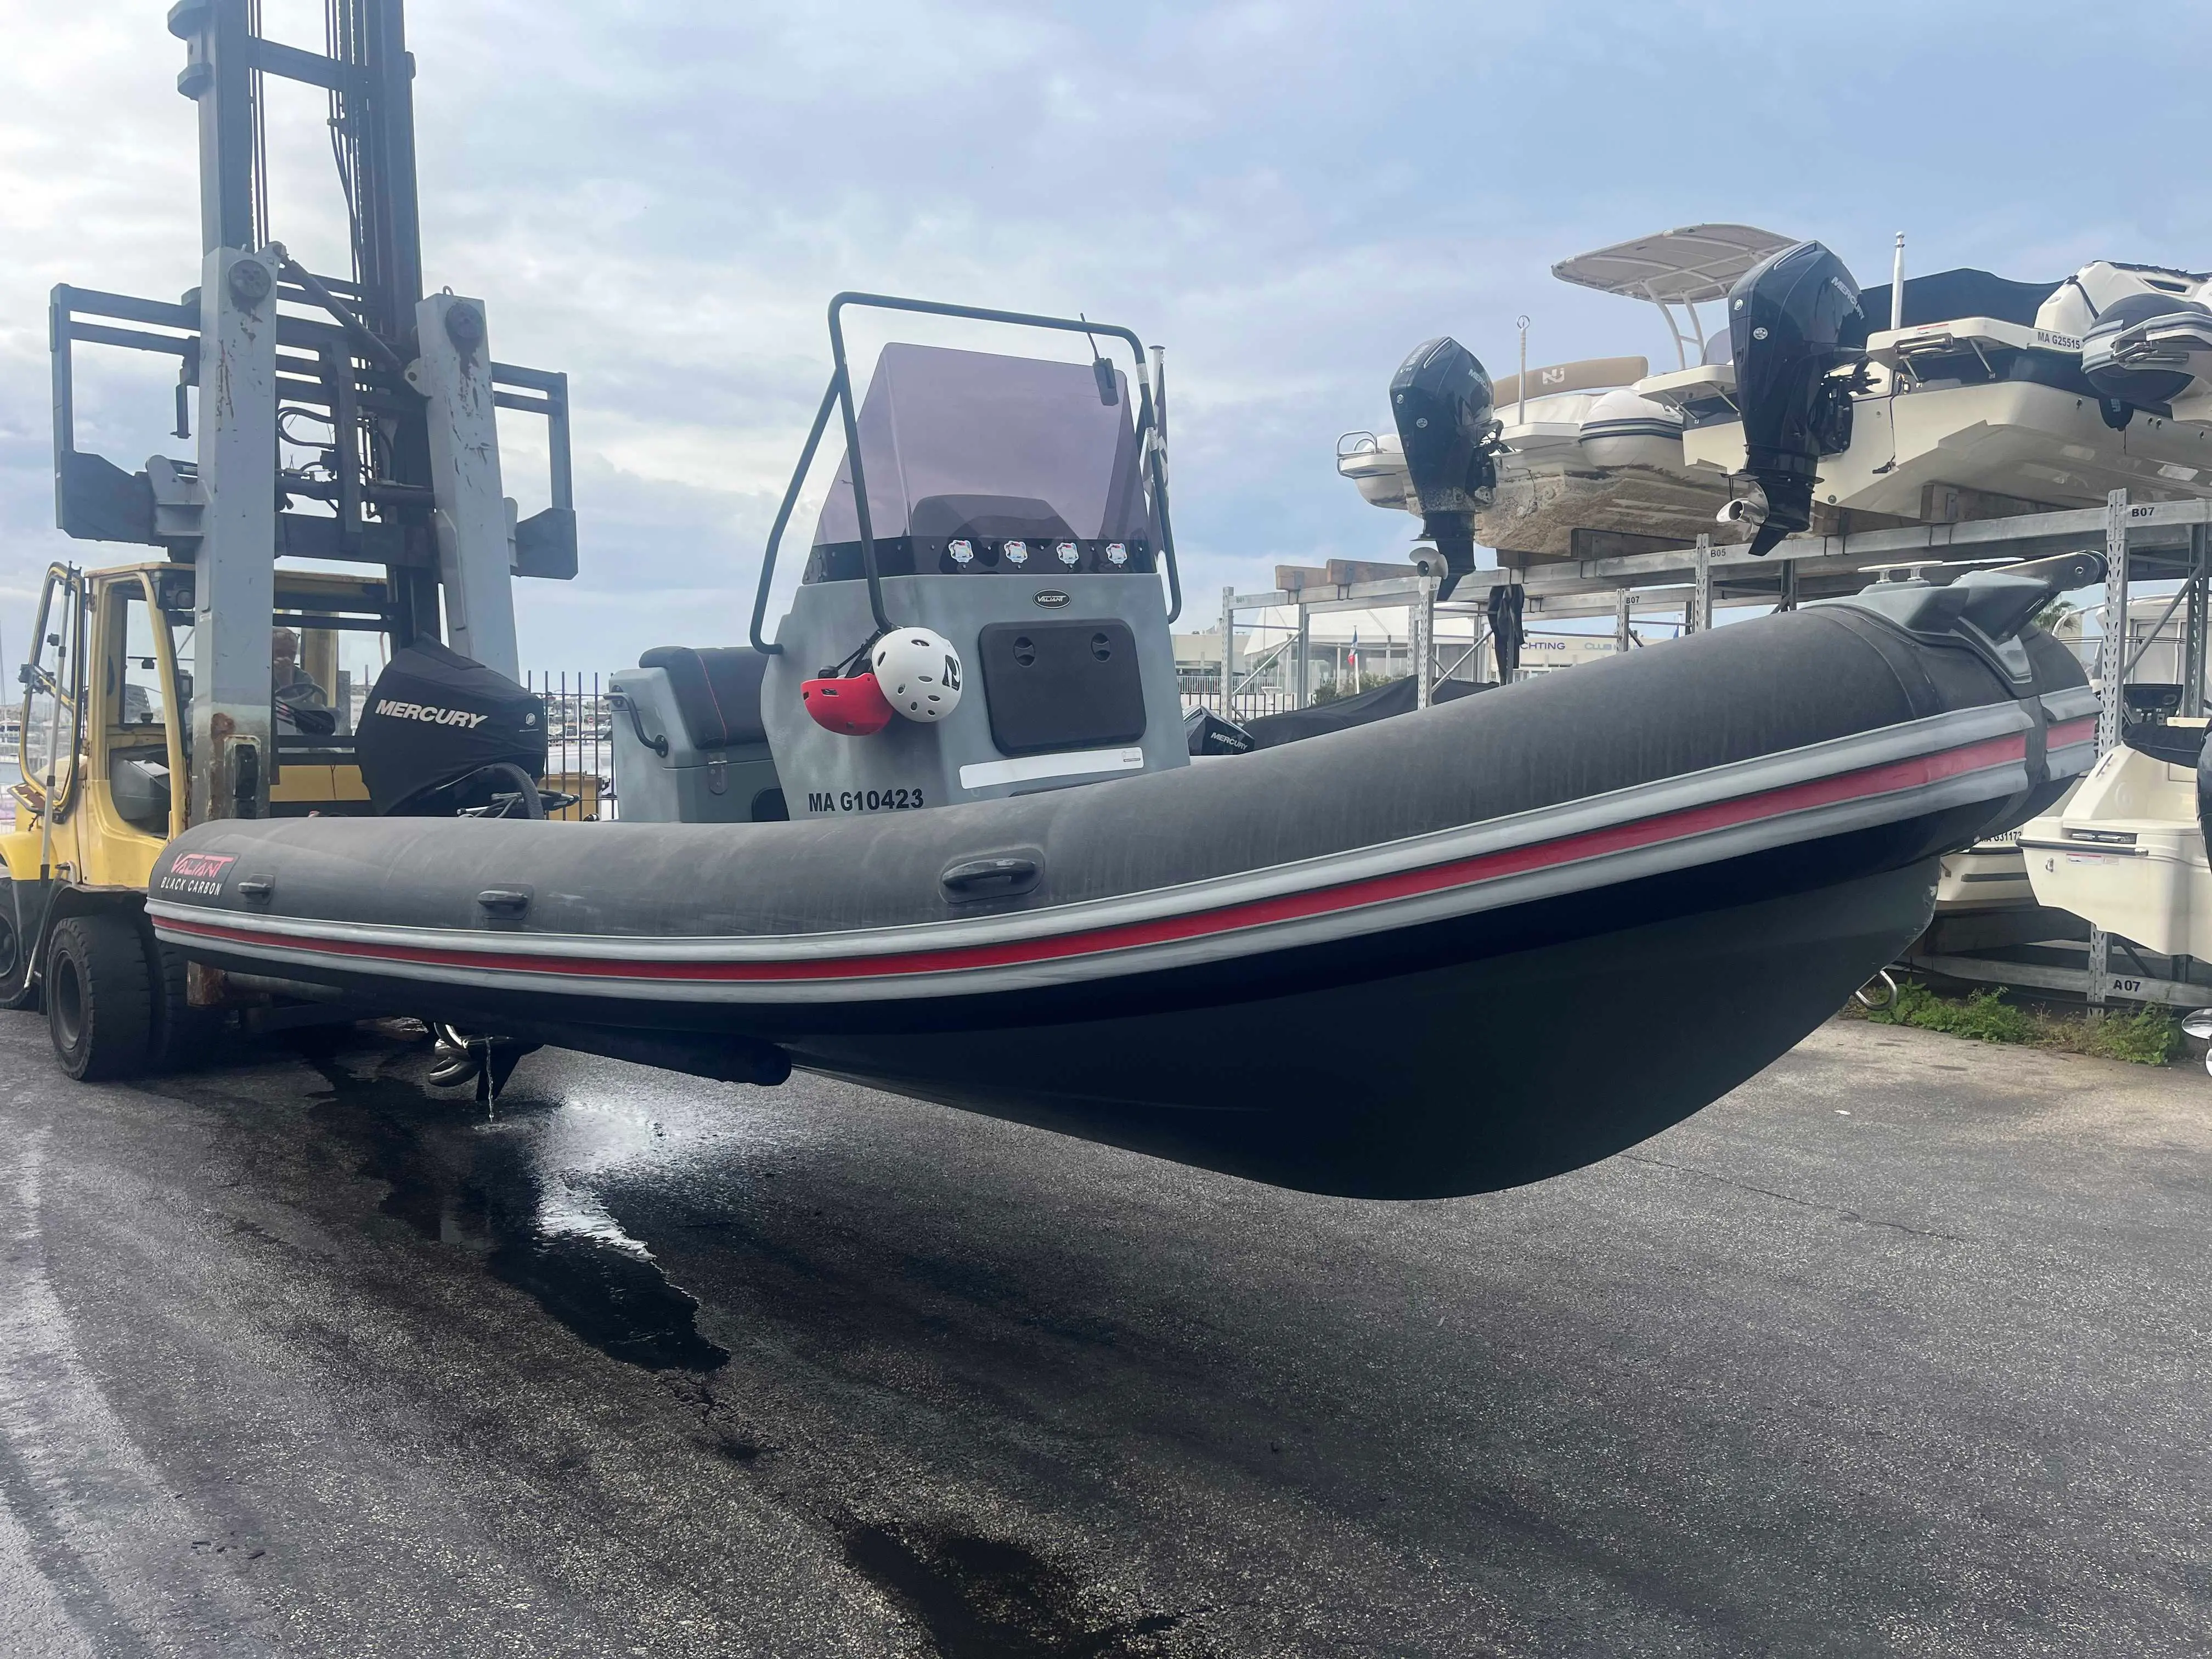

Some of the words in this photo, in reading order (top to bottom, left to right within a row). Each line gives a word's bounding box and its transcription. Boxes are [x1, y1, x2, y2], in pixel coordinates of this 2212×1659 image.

[1831, 276, 1864, 319] MERCURY
[2038, 331, 2050, 343] MA
[2052, 335, 2080, 349] G25515
[2132, 506, 2155, 517] B07
[1711, 549, 1726, 558] B05
[1626, 596, 1639, 604] B07
[1520, 642, 1566, 650] CHTING
[375, 699, 488, 729] MERCURY
[1210, 732, 1248, 750] MERCURY
[809, 793, 836, 812] MA
[840, 788, 923, 811] G10423
[171, 853, 235, 878] VALIANT
[160, 877, 187, 891] BLACK
[188, 879, 222, 896] CARBON
